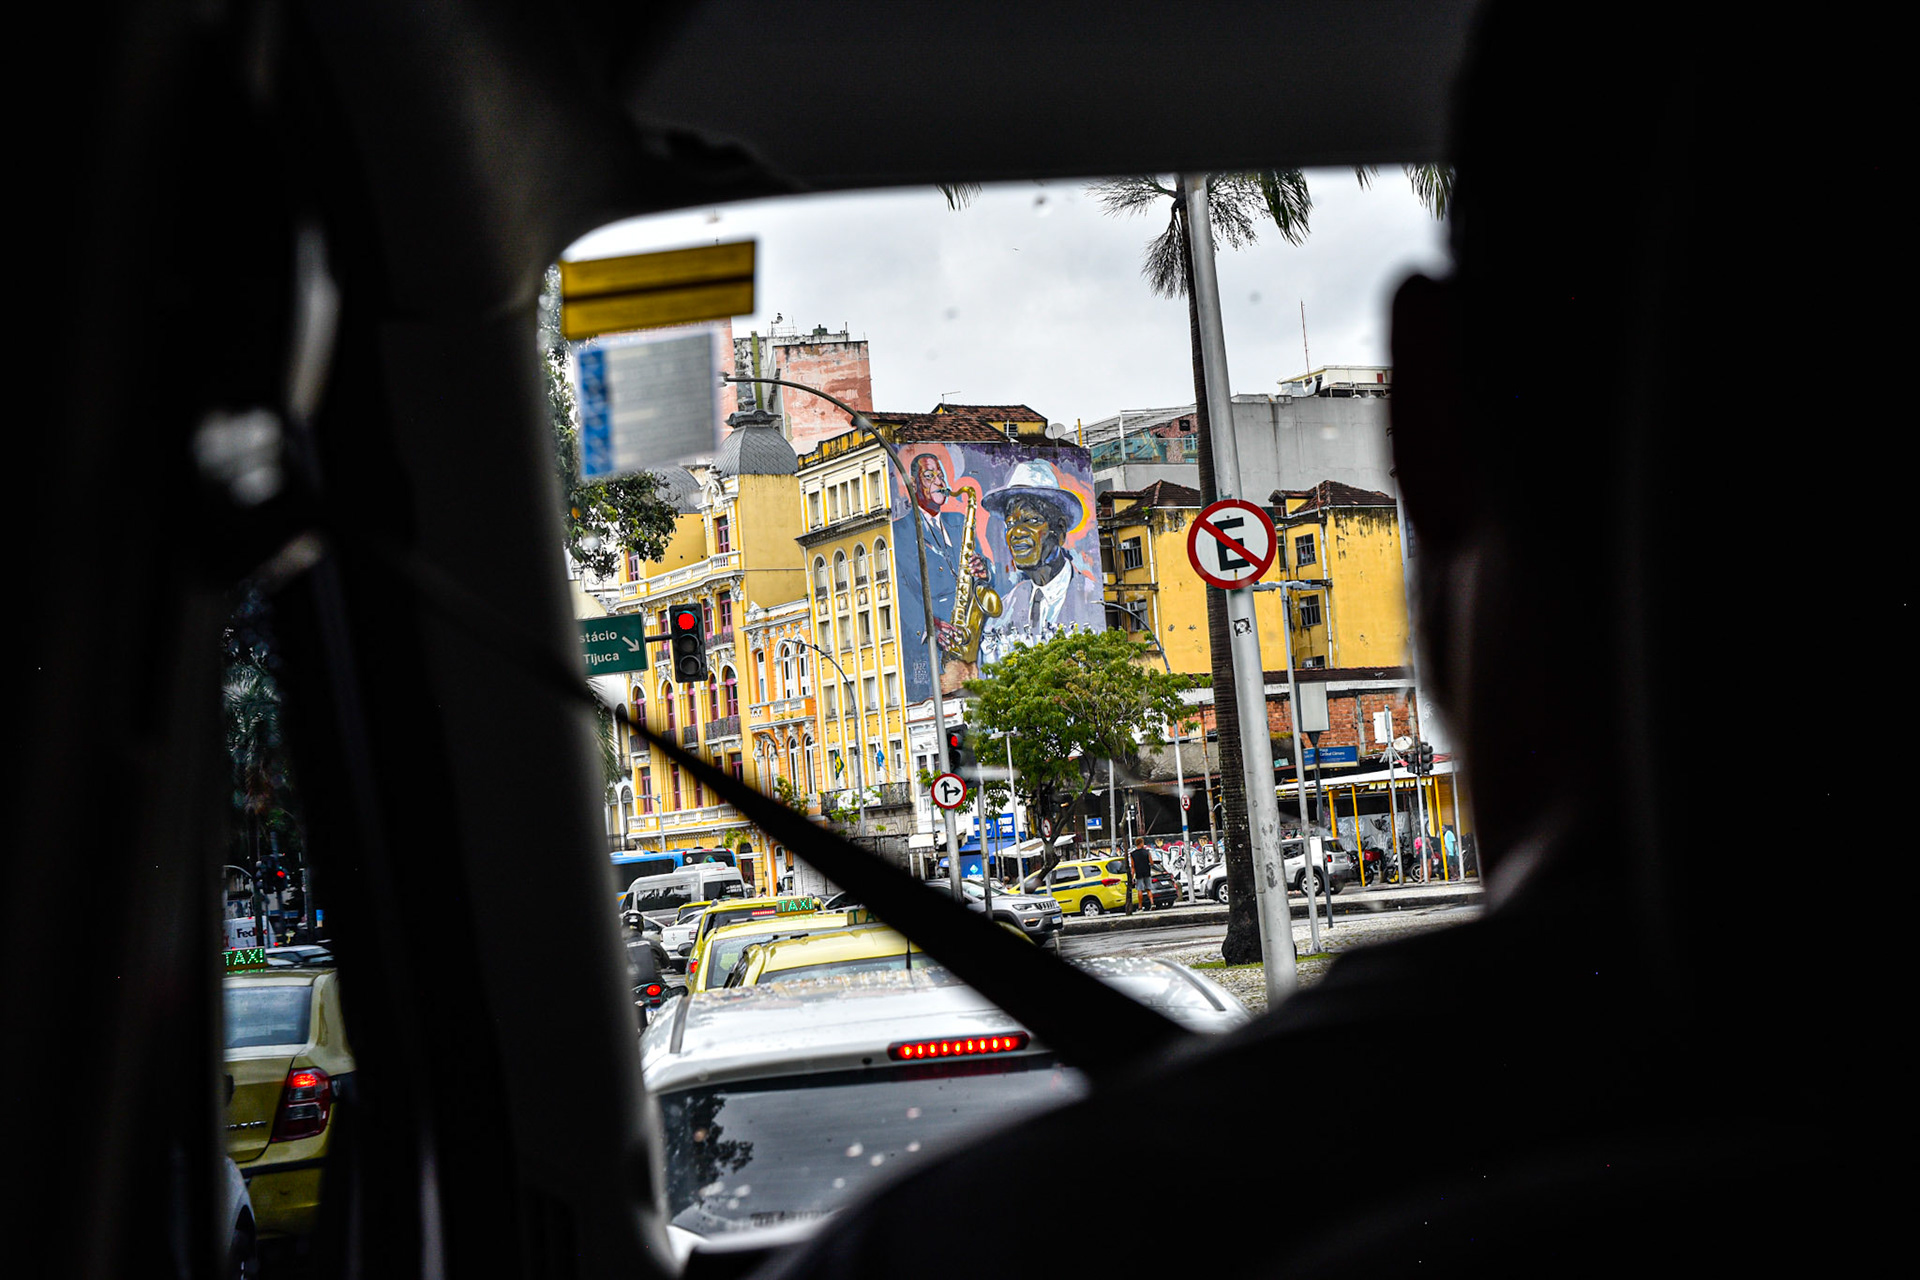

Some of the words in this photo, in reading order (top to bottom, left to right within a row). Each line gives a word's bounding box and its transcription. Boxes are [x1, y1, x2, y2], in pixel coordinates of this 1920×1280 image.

[1213, 516, 1251, 572] E
[579, 630, 617, 643] stácio
[584, 653, 619, 666] Tijuca
[778, 897, 812, 912] TAXI
[850, 909, 877, 925] TA
